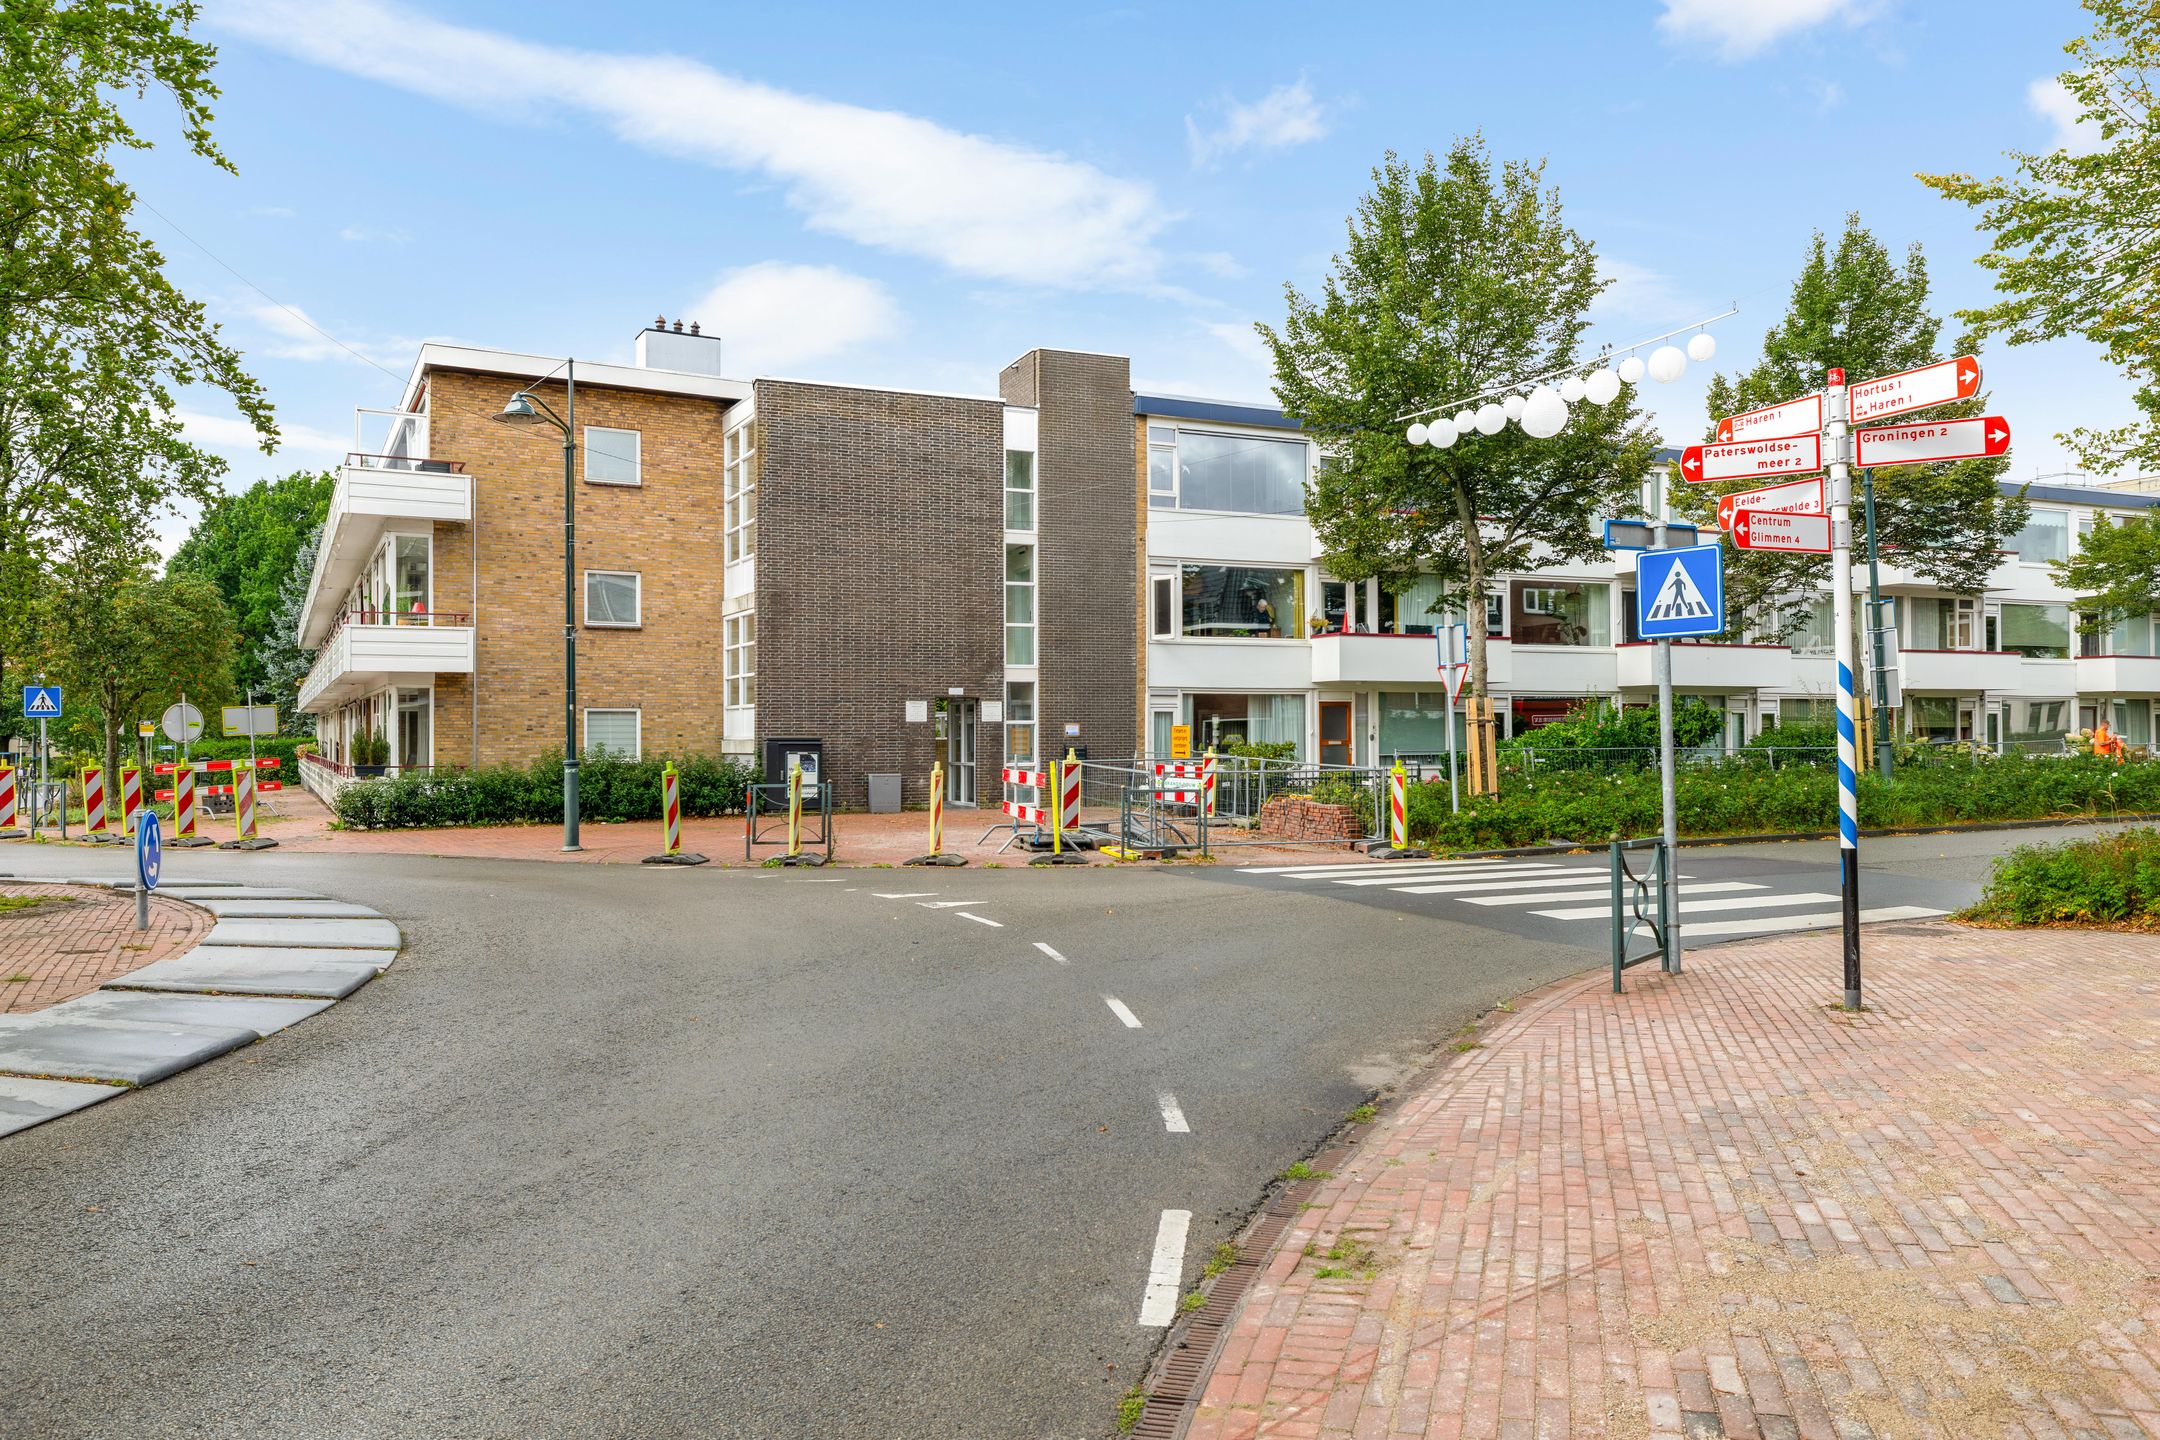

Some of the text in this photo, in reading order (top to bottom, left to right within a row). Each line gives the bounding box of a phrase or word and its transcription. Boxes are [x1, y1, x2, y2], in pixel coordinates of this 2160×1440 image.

[1855, 381, 1902, 399] Hortus 1
[1870, 395, 1912, 412] Haren 1
[1745, 411, 1775, 427] Haren
[1778, 411, 1782, 419] 1
[1862, 427, 1948, 443] Groningen 2
[1704, 442, 1799, 458] Paterswoldse-
[1757, 457, 1802, 469] meer 2
[1734, 495, 1766, 507] Eelde-
[1814, 500, 1819, 508] 3
[1750, 515, 1791, 527] Centrum
[1751, 532, 1800, 544] Glimmen 4
